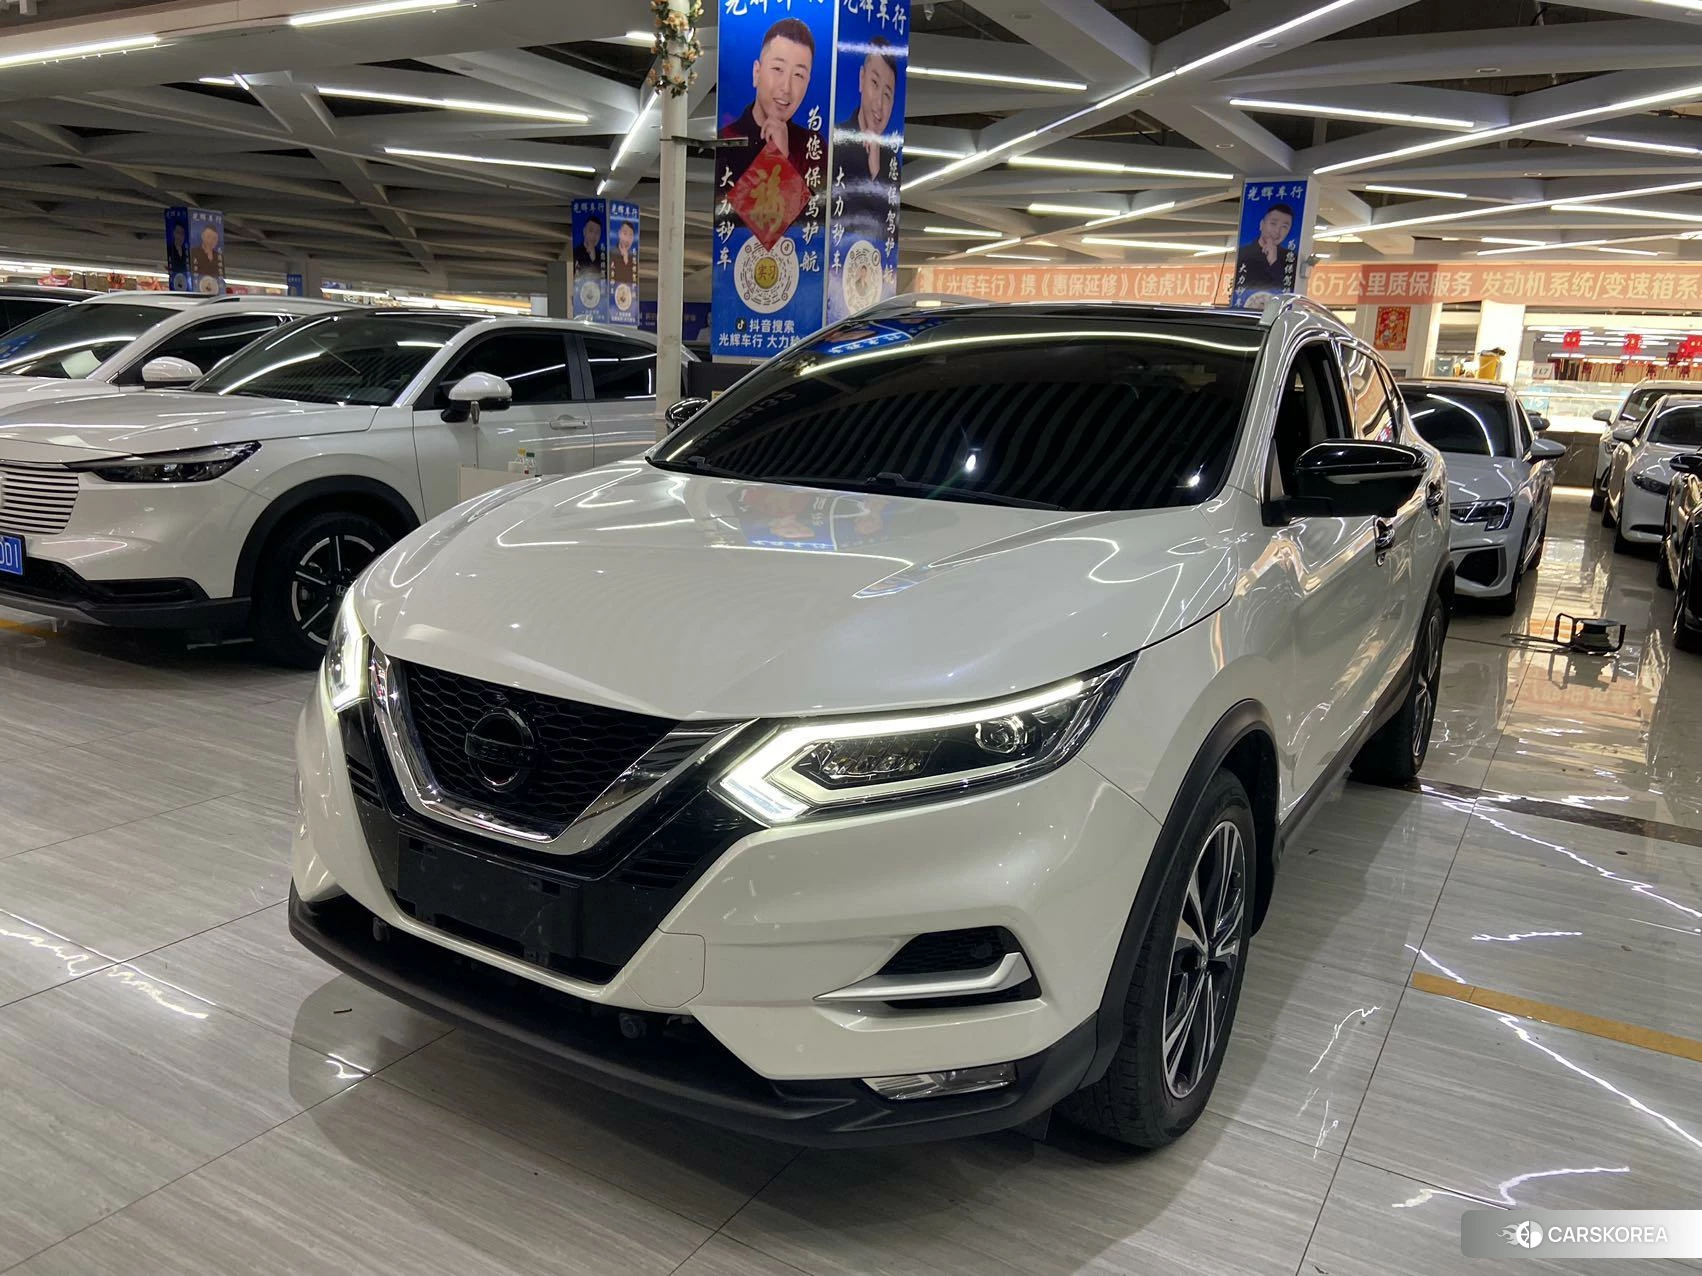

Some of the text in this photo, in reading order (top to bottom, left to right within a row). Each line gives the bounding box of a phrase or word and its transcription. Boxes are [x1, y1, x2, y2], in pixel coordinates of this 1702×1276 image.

[1312, 271, 1473, 298] 6万公里质保服务
[749, 319, 796, 334] 抖音搜索
[718, 332, 763, 348] 光辉车行
